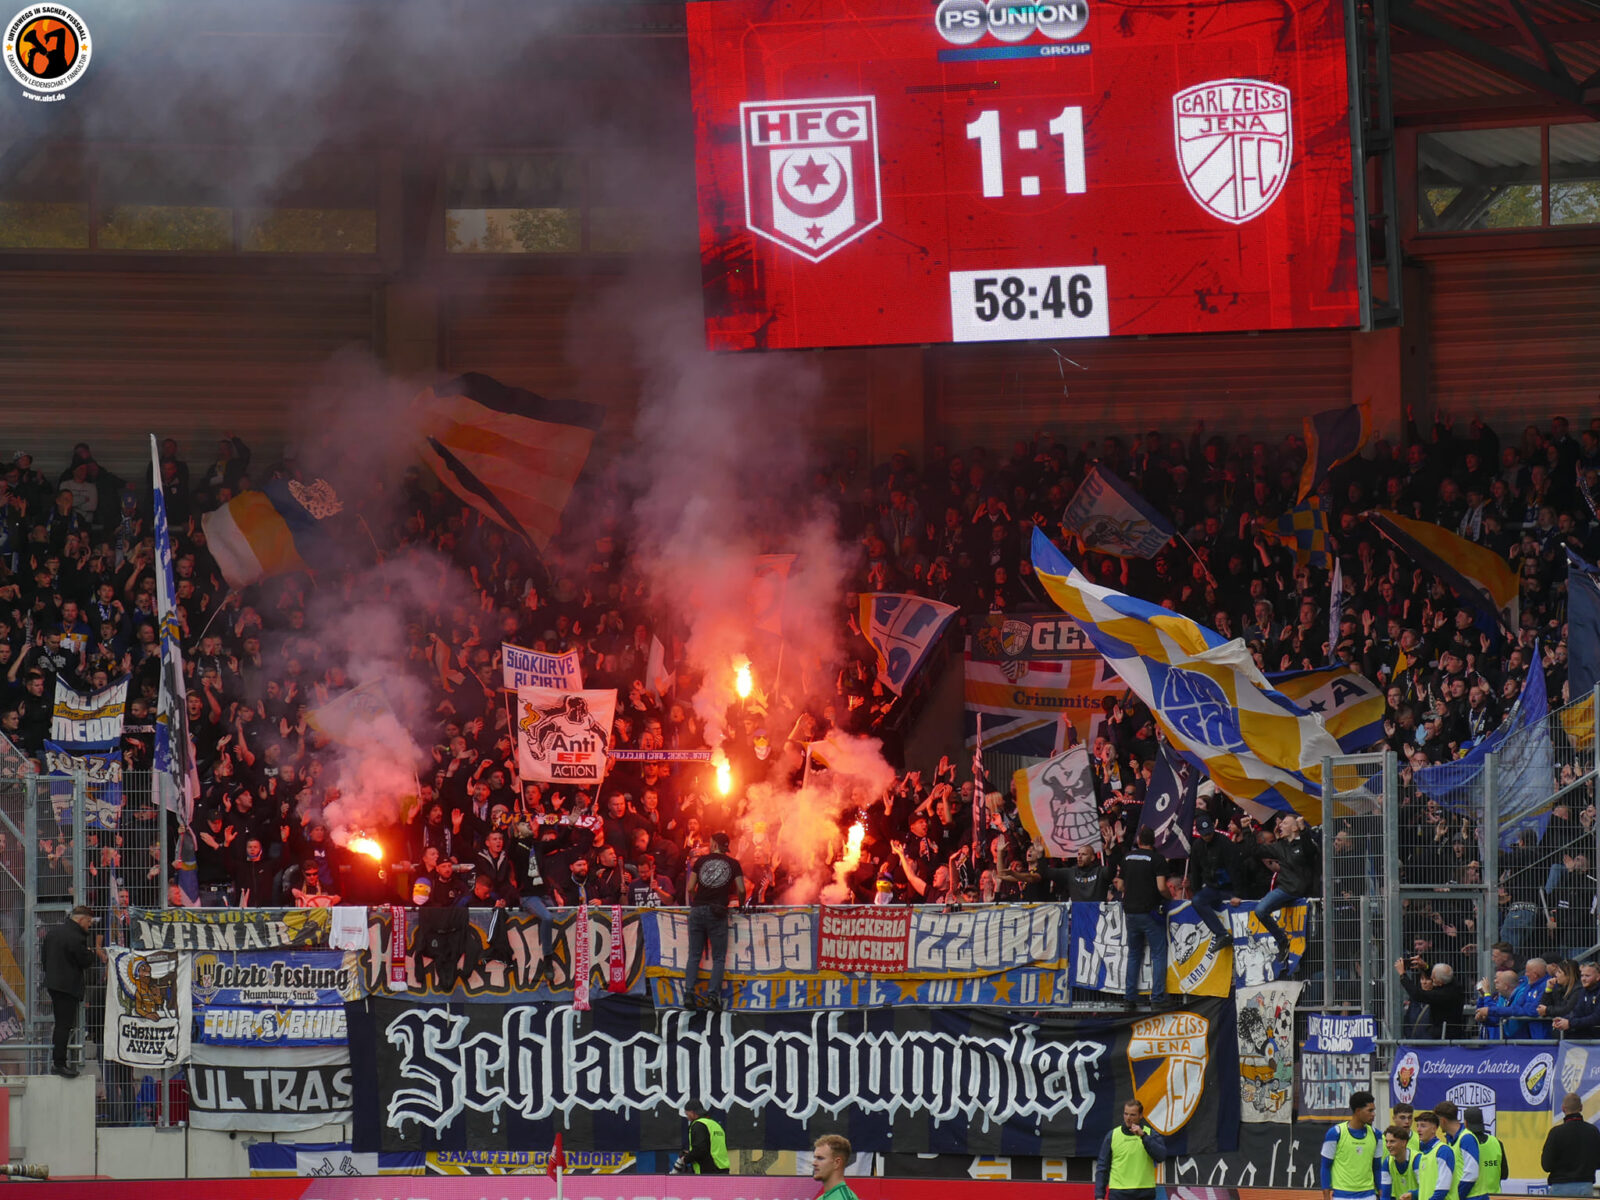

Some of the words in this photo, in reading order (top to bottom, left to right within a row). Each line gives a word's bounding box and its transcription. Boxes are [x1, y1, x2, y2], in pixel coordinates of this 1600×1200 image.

[945, 10, 981, 28] PS
[989, 4, 1078, 26] UNION
[1040, 44, 1091, 55] GROUP
[1182, 89, 1230, 113] CARL
[1231, 87, 1282, 111] ZEISS
[758, 108, 861, 143] HFC
[1200, 115, 1268, 133] JENA
[966, 106, 1087, 198] 1:1
[973, 273, 1093, 322] 58:46
[506, 649, 575, 676] SÜDKURVE
[551, 734, 596, 753] Anti
[556, 752, 592, 763] EF
[553, 765, 596, 778] ACTION
[137, 920, 293, 951] WEIMAR
[822, 916, 907, 938] SCHICKERIA
[656, 911, 813, 971] HRDA
[821, 936, 905, 961] MÜNCHEN
[213, 963, 269, 988] Letzte
[271, 962, 350, 991] Festung
[928, 979, 987, 1004] MIT
[1020, 971, 1070, 1005] UNS
[1136, 1016, 1166, 1037] CARL
[1167, 1015, 1204, 1036] ZEISS
[1322, 1018, 1348, 1038] BLUE
[126, 1039, 165, 1055] AWAY
[1143, 1040, 1192, 1054] JENA
[385, 1005, 1107, 1132] Schlachtenbummler
[1302, 1053, 1371, 1080] REFUGEES
[1422, 1057, 1475, 1079] Ostbayern
[1477, 1059, 1520, 1075] Chaoten
[190, 1067, 353, 1111] ULTRAS
[1448, 1085, 1469, 1104] CARL
[1469, 1085, 1492, 1104] ZEISS
[436, 1150, 529, 1165] SAALFELD
[1483, 1159, 1499, 1168] SSE
